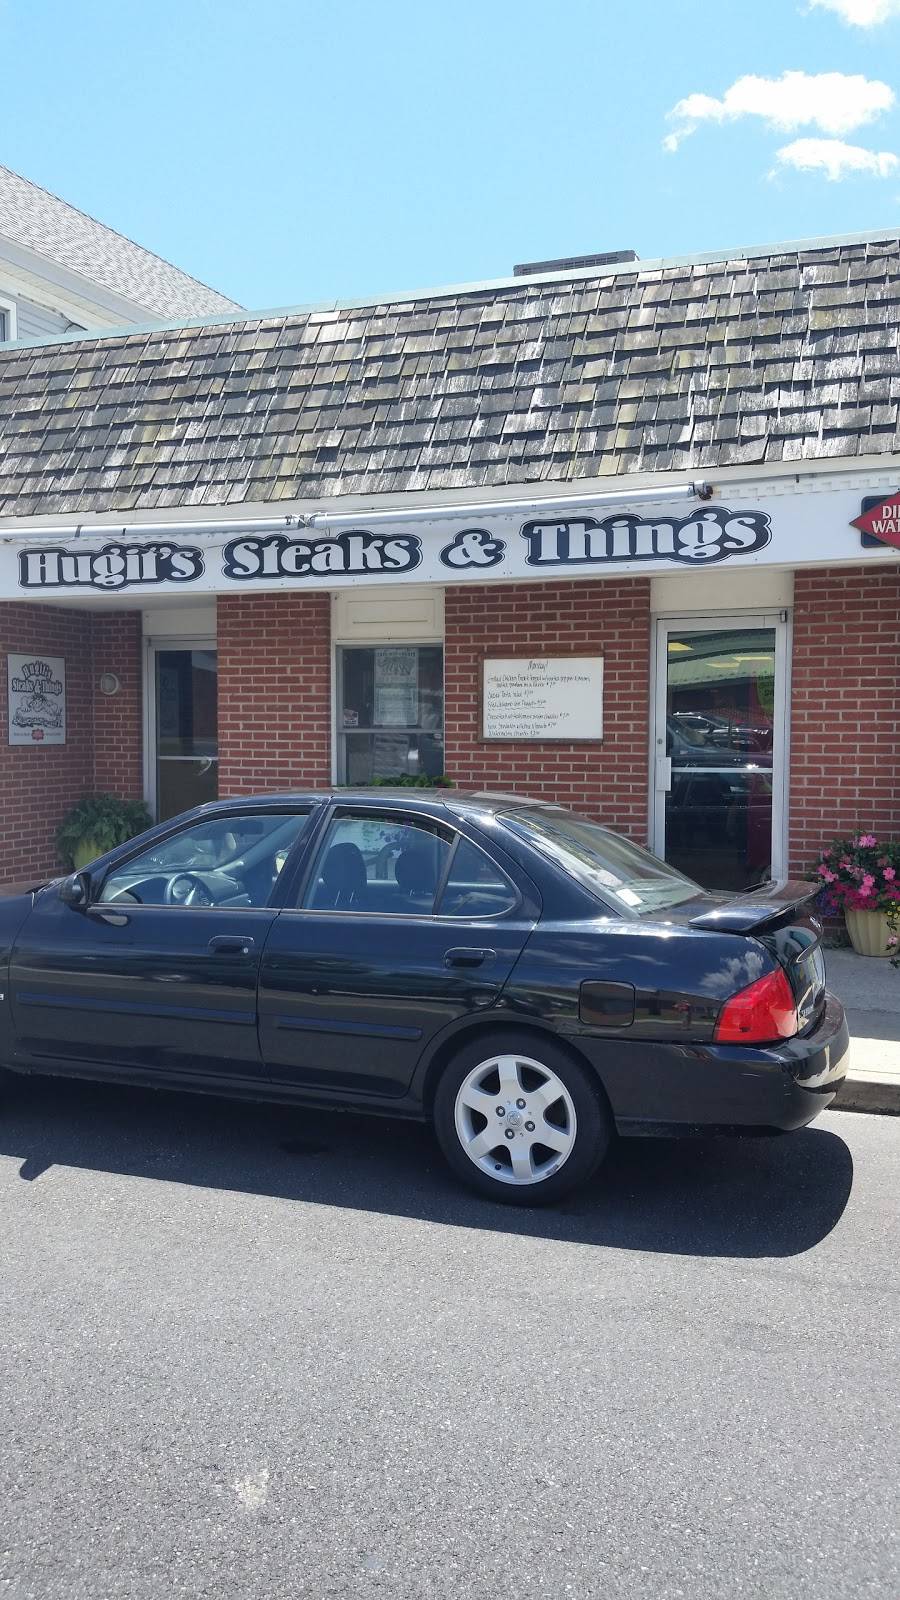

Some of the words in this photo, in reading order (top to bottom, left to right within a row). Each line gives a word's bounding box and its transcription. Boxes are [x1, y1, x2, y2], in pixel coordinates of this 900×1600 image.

[232, 536, 411, 575] Steaks
[447, 533, 497, 565] &
[532, 512, 757, 561] Things
